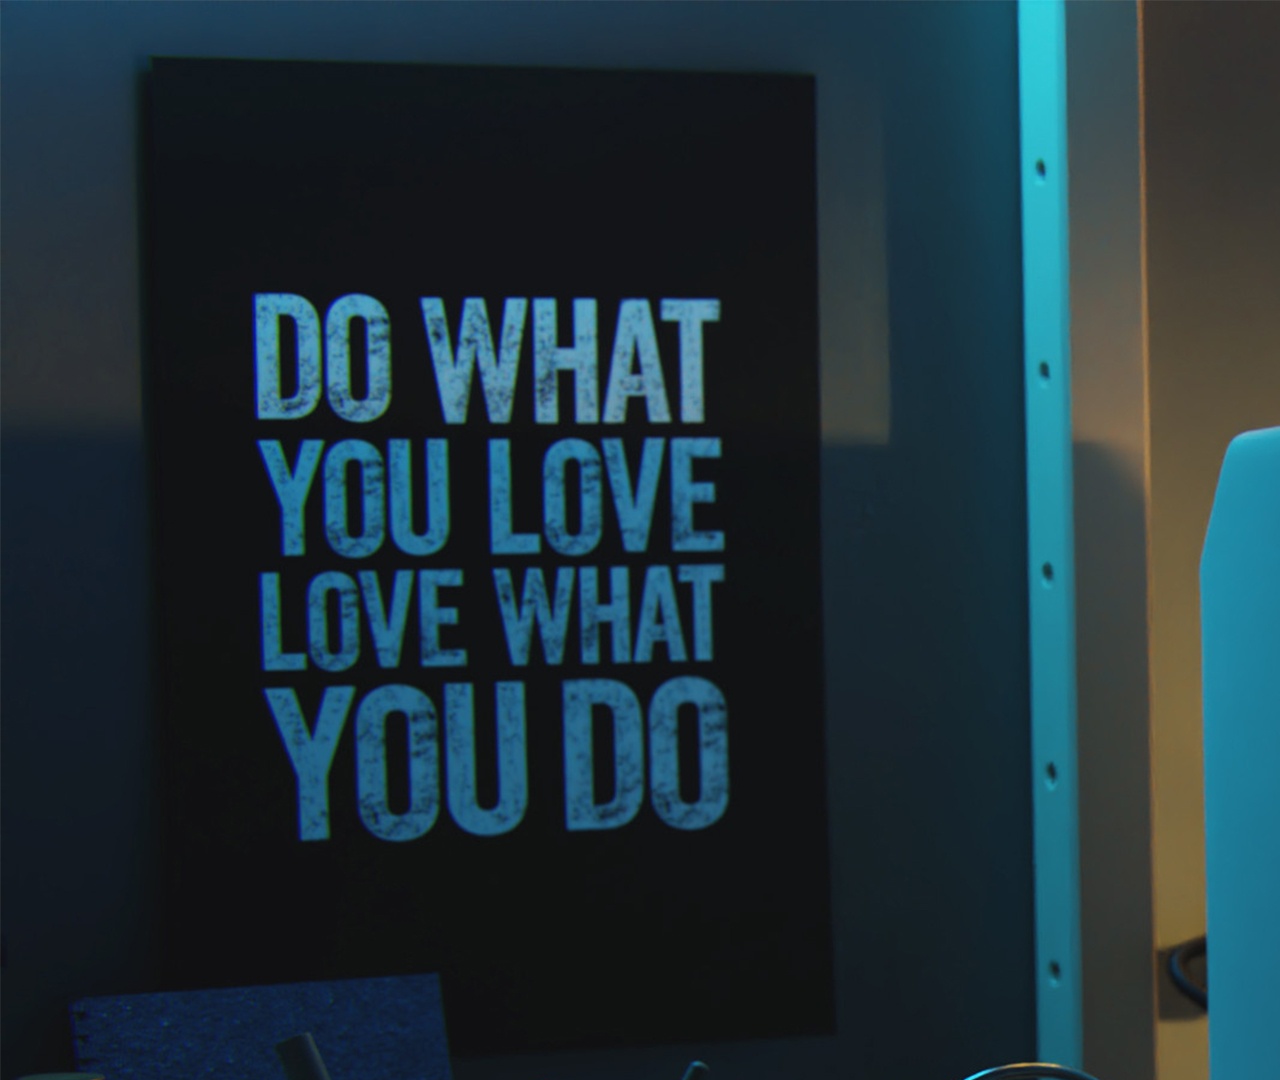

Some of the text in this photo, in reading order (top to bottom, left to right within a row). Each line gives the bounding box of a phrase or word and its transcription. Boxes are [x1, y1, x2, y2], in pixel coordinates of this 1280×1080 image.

[253, 293, 721, 424] DO WHAT
[256, 437, 726, 559] YOU LOVE
[260, 564, 726, 672] LOVE WHAT
[264, 676, 730, 842] YOU DO
